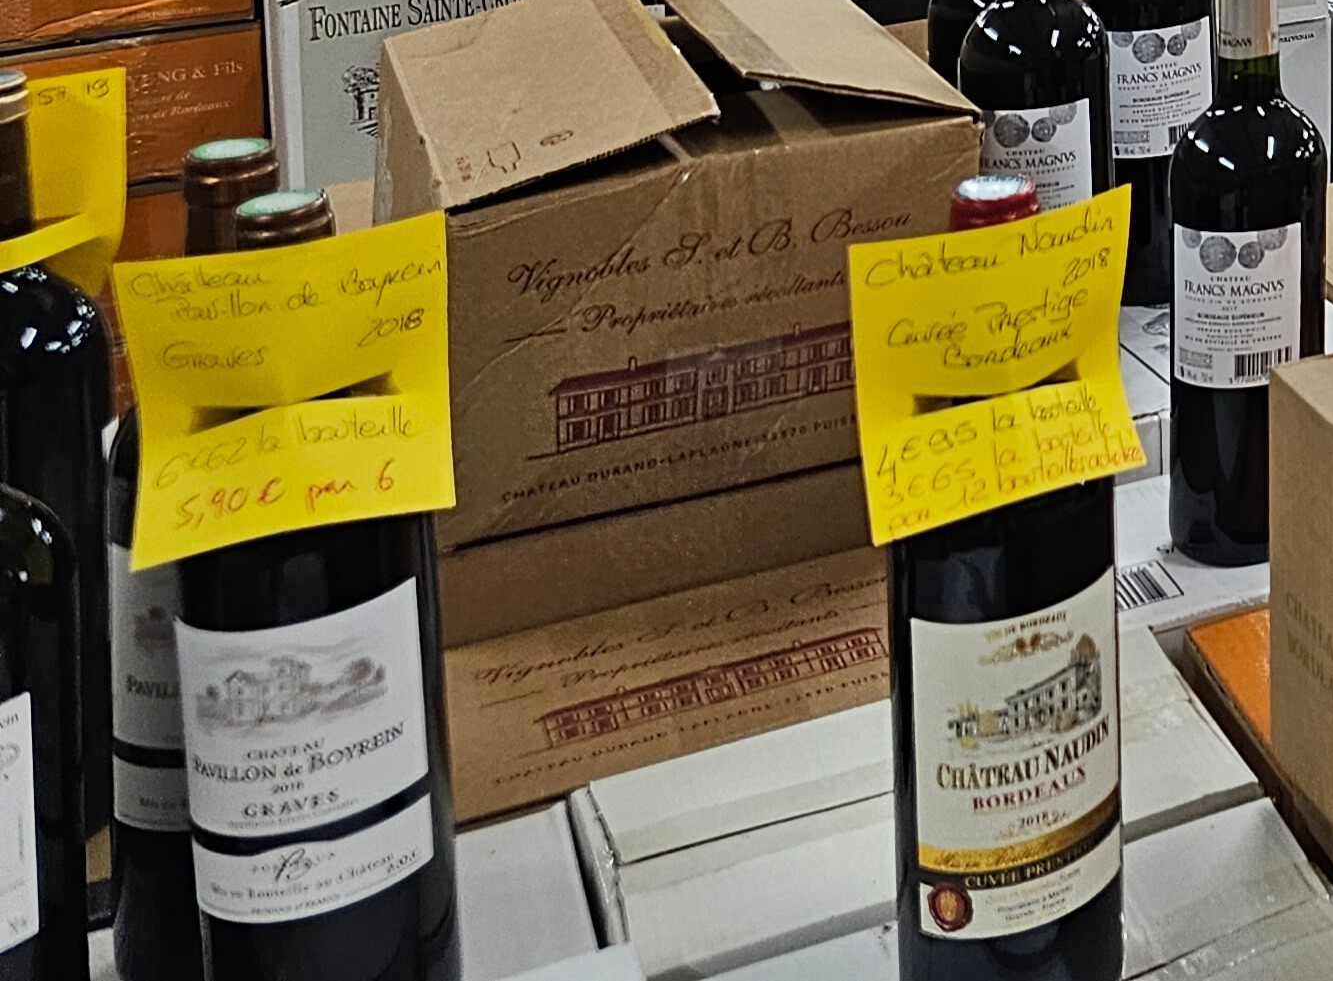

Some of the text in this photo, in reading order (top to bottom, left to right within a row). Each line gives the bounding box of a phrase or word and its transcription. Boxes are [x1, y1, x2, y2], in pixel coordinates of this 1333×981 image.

[309, 1, 402, 41] FONTAINE
[190, 61, 244, 82] & Fils
[1116, 70, 1159, 86] FRANCS
[506, 249, 652, 301] Vignobles
[865, 242, 1001, 288] Château
[1063, 247, 1111, 287] 2018
[131, 270, 272, 297] Château
[1183, 280, 1226, 297] FRANCS
[942, 324, 1072, 369] Bordeaux
[990, 406, 1016, 432] la
[994, 443, 1018, 468] la
[378, 458, 396, 491] 6
[192, 722, 405, 782] PAVILLON de BOYREIN
[936, 715, 1110, 790] CHÂTEAU NAUDIN
[242, 789, 340, 818] GRAVES
[973, 765, 1087, 812] BORDEAUX
[965, 867, 1022, 889] CUVÉE
